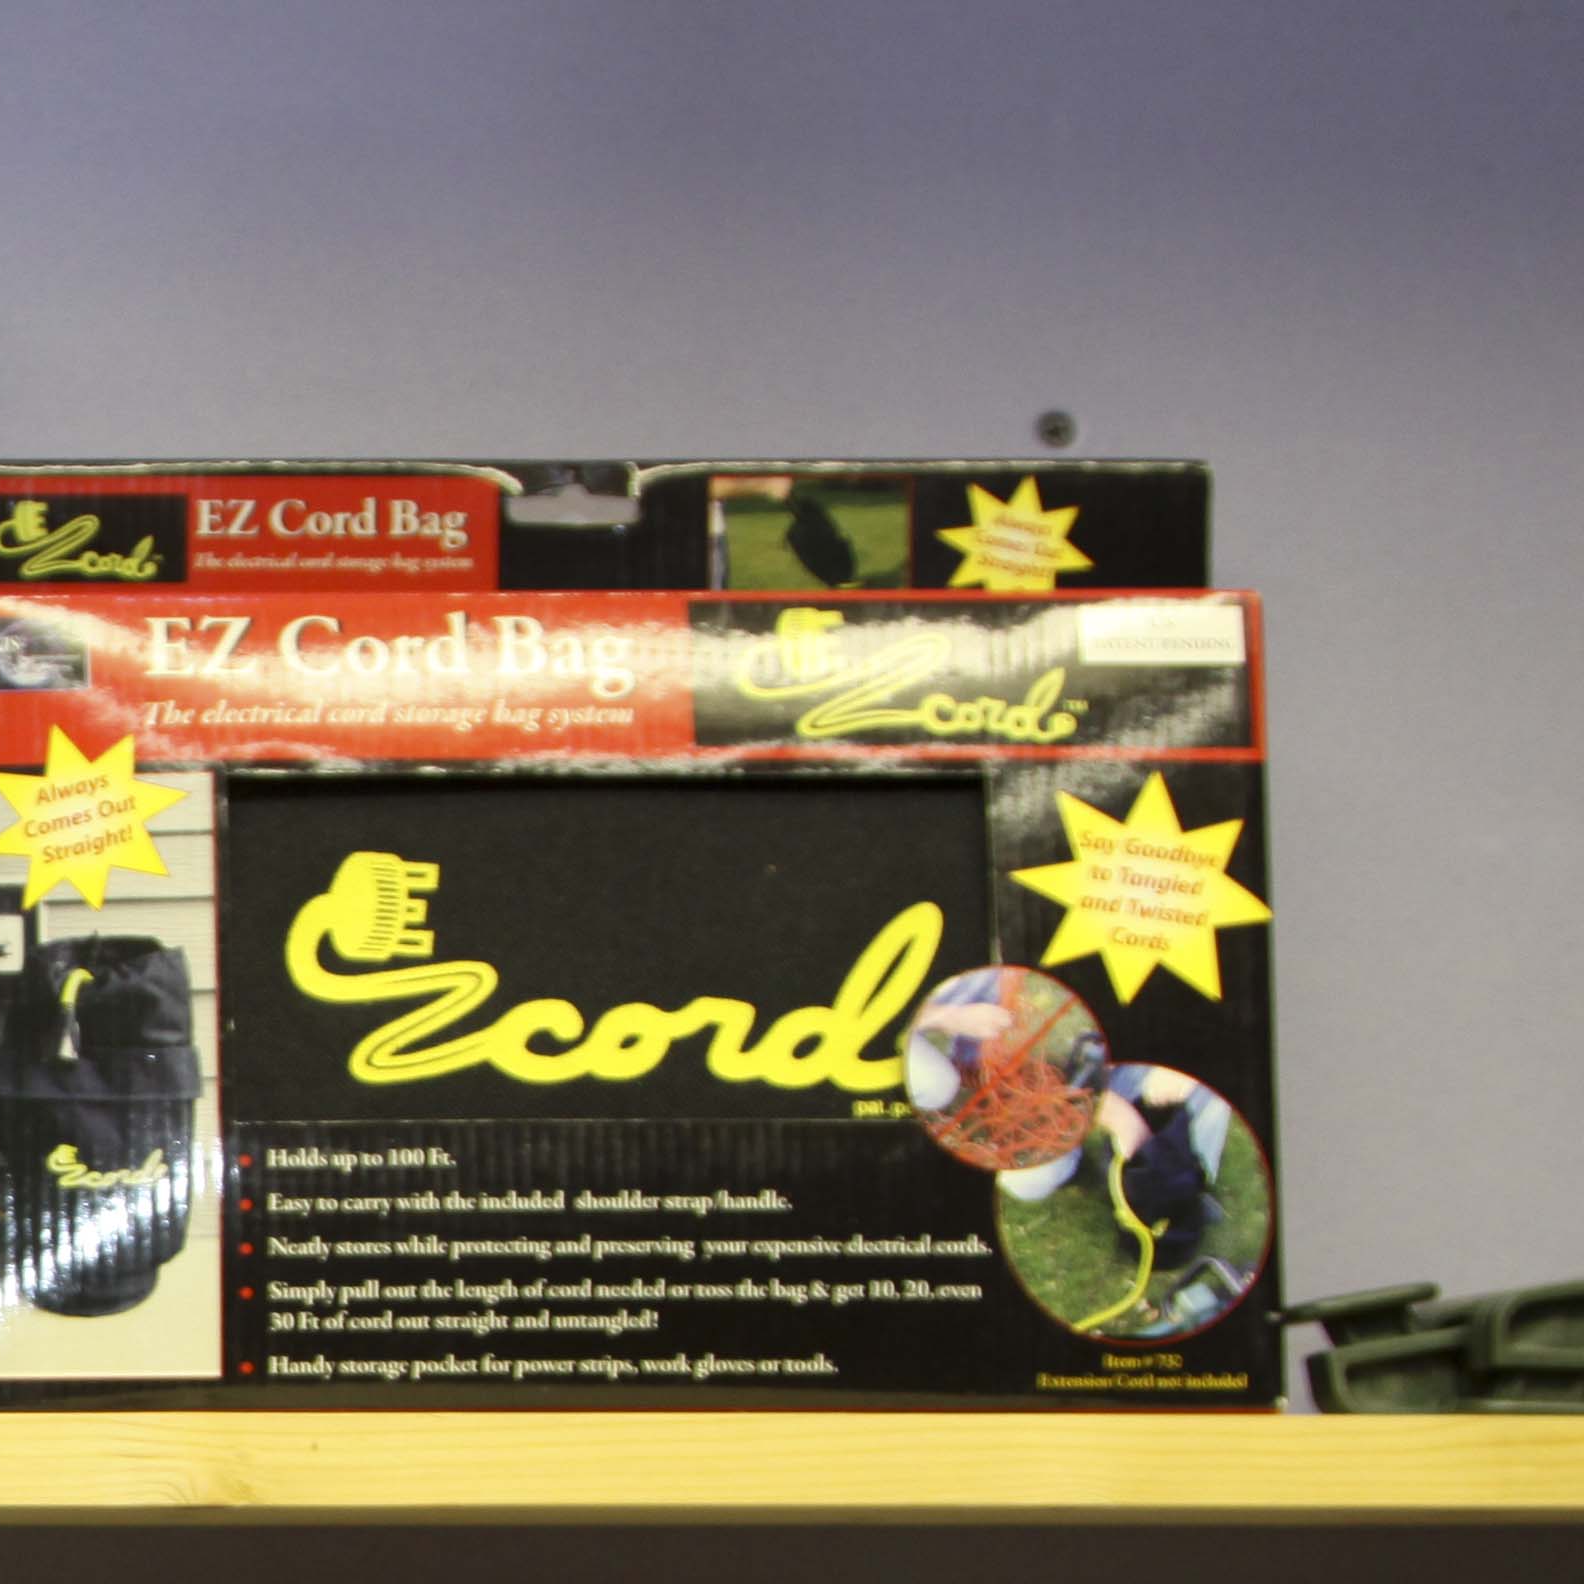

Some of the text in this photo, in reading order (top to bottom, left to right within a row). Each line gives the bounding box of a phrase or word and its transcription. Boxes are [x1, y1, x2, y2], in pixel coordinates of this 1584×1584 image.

[195, 497, 469, 550] EZ Cord Bag
[143, 611, 636, 699] EZ Cord Bag
[144, 701, 635, 732] The electrical cord storage bag system
[35, 774, 110, 806] Always
[23, 795, 136, 839] Comes Out
[41, 824, 134, 864] Straight!
[1080, 830, 1217, 868] Say Goodbye
[1091, 863, 1205, 896] to Tangled
[1081, 893, 1208, 927] and Twisted
[1110, 925, 1171, 952] Cords
[266, 1147, 457, 1177] Holds up to 100 Ft.
[267, 1189, 661, 1217] Easy to carry with the included shoulder
[267, 1233, 993, 1263] Neatly stores while protecting and preserving your expensive electrical cords.
